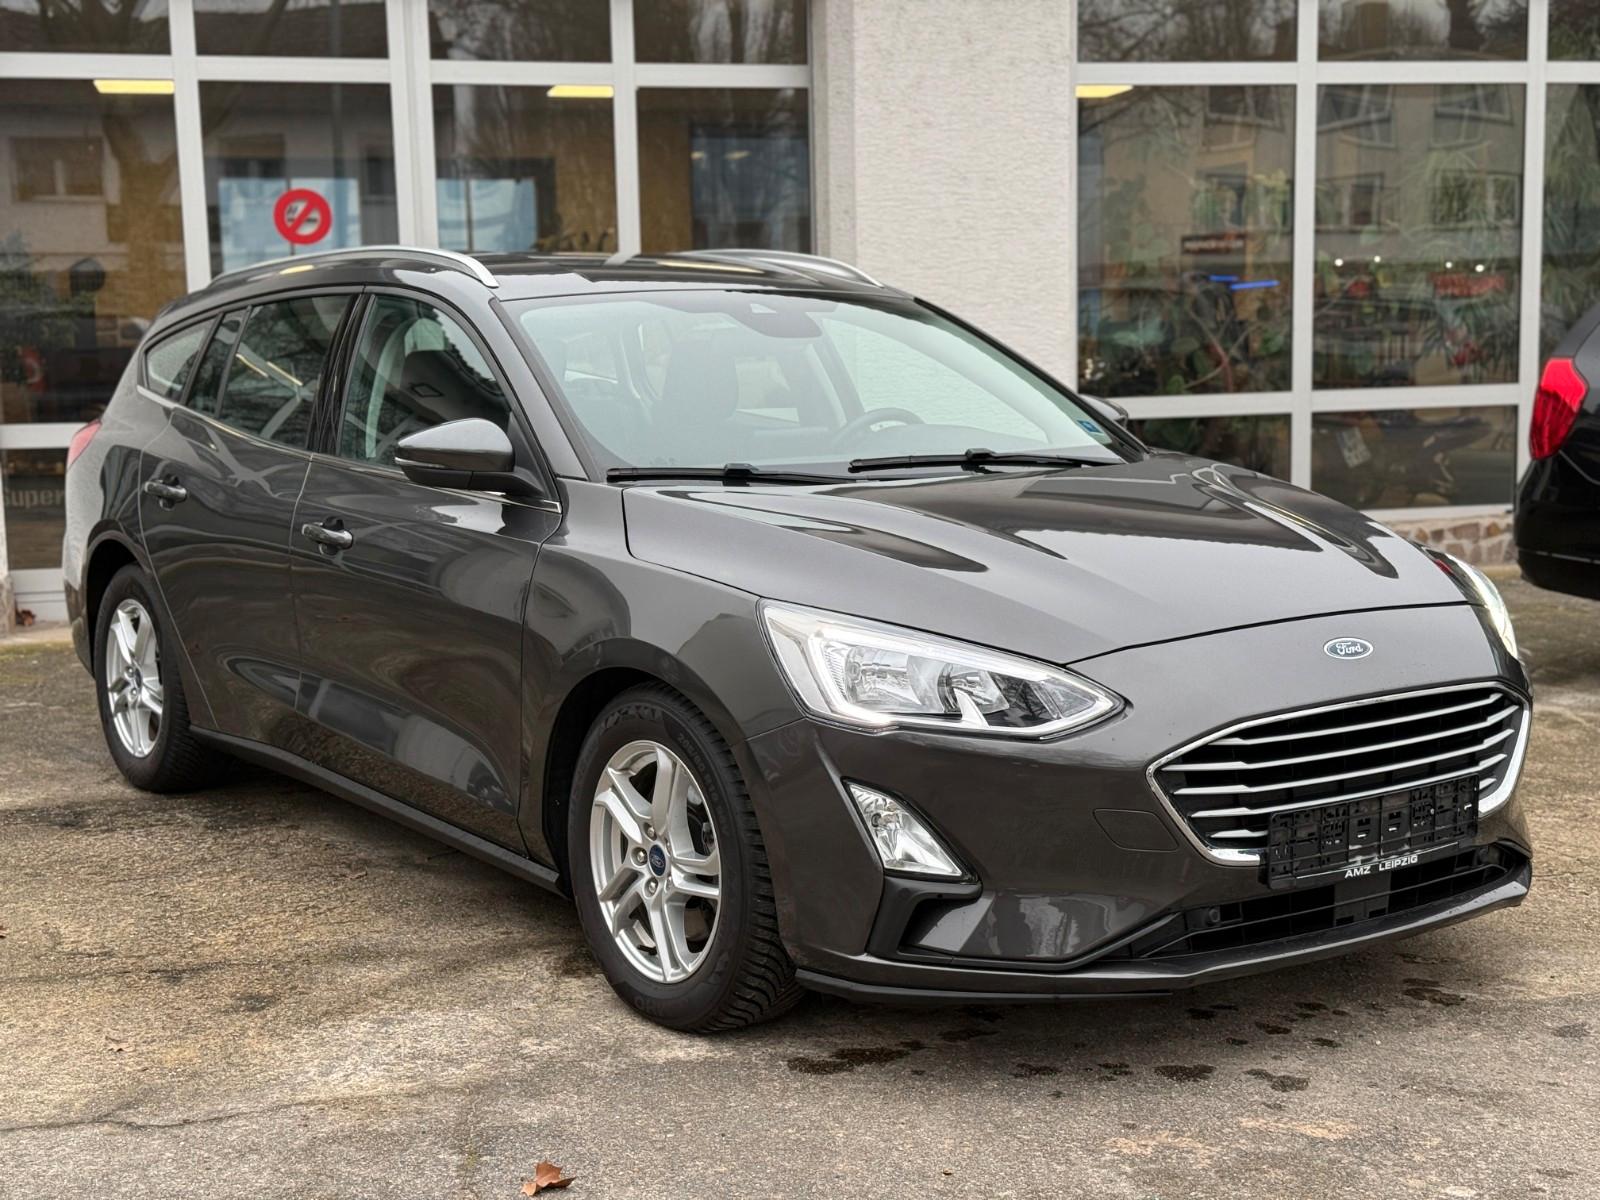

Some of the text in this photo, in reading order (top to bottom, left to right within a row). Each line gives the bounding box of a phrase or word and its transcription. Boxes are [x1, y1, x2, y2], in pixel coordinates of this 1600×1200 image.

[1336, 641, 1364, 655] Ford
[1344, 854, 1419, 879] AMZ LEIPZIG
